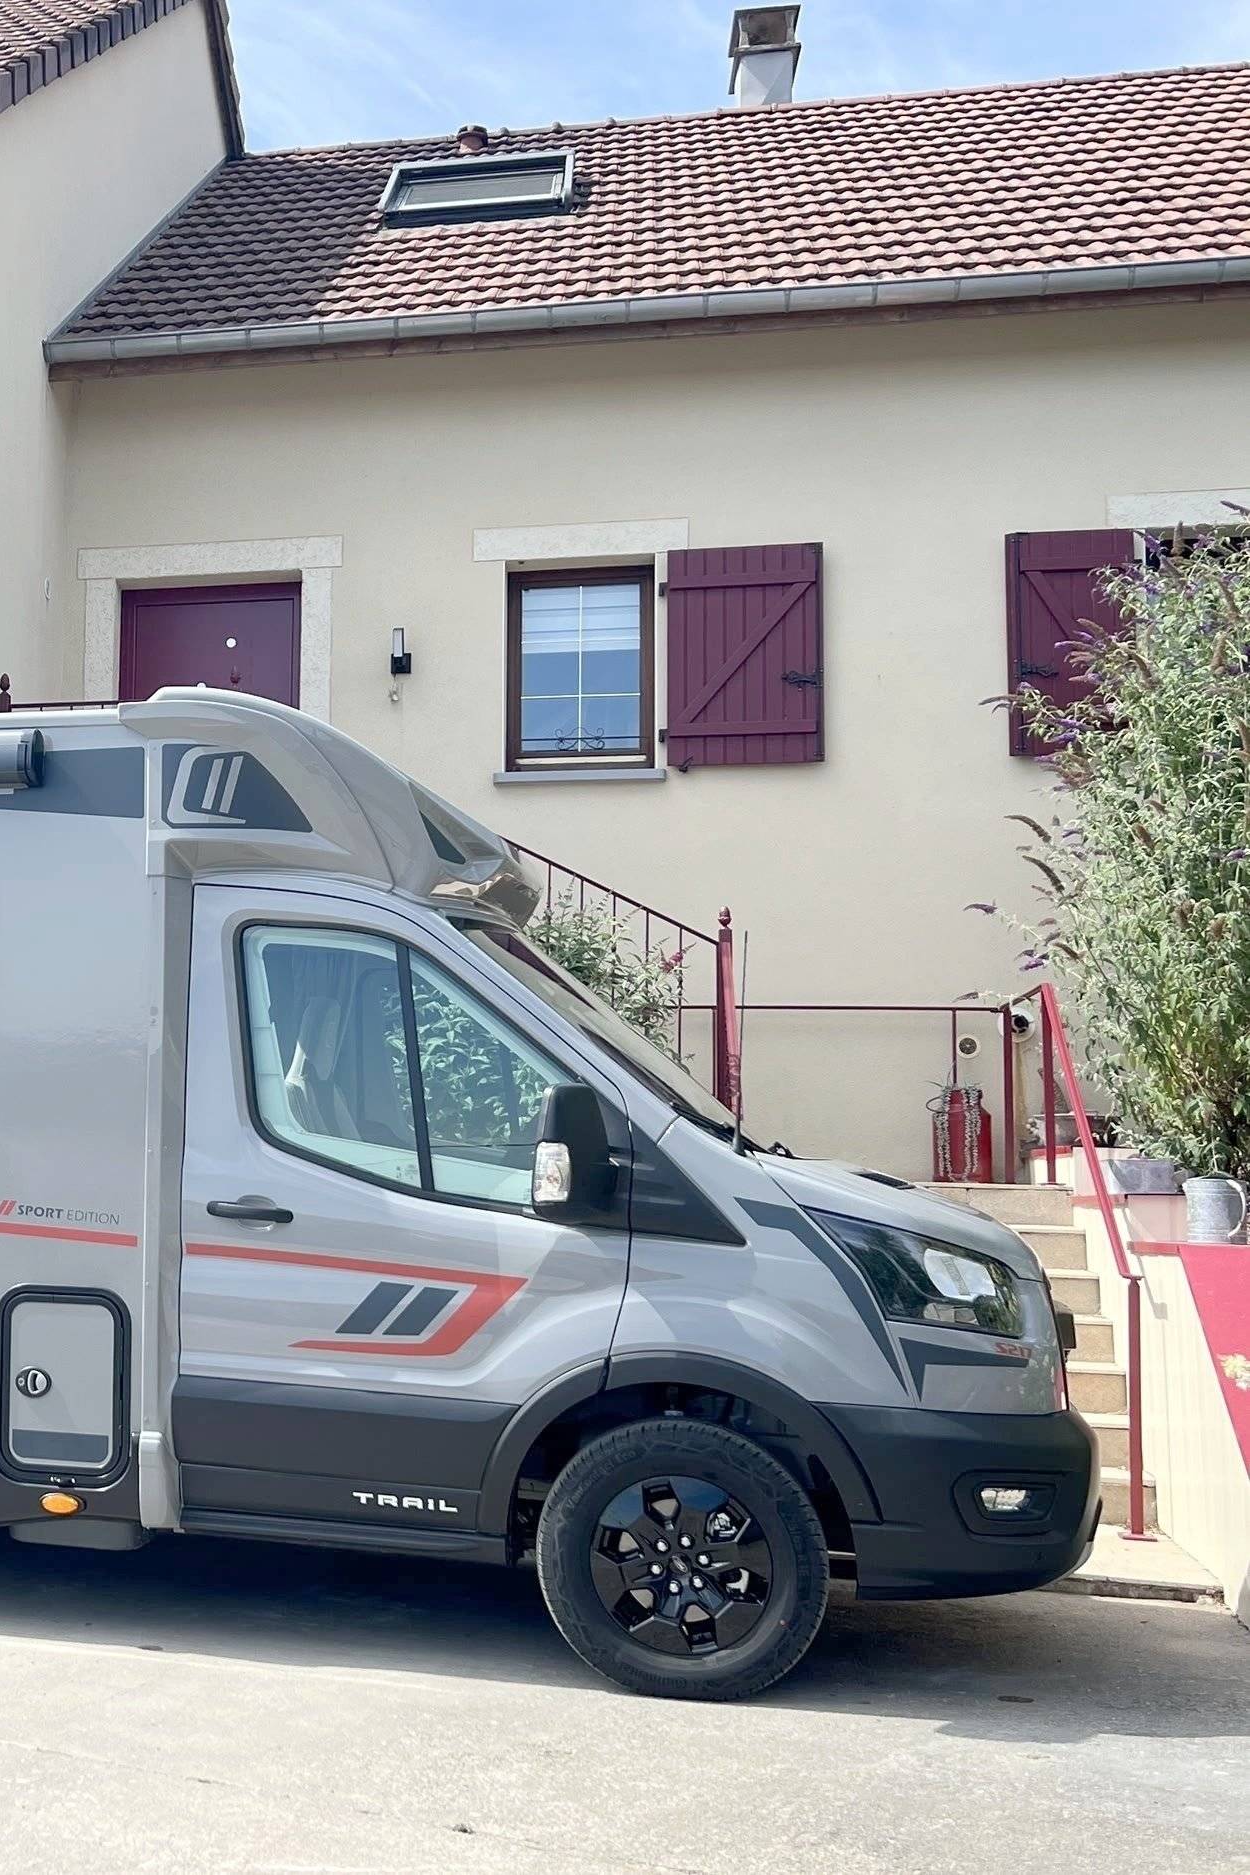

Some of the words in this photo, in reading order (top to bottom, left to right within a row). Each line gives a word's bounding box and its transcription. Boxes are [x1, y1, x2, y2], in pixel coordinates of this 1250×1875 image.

[17, 1204, 64, 1219] SPORT
[67, 1209, 120, 1225] EDITION
[352, 1491, 458, 1513] TRAIL
